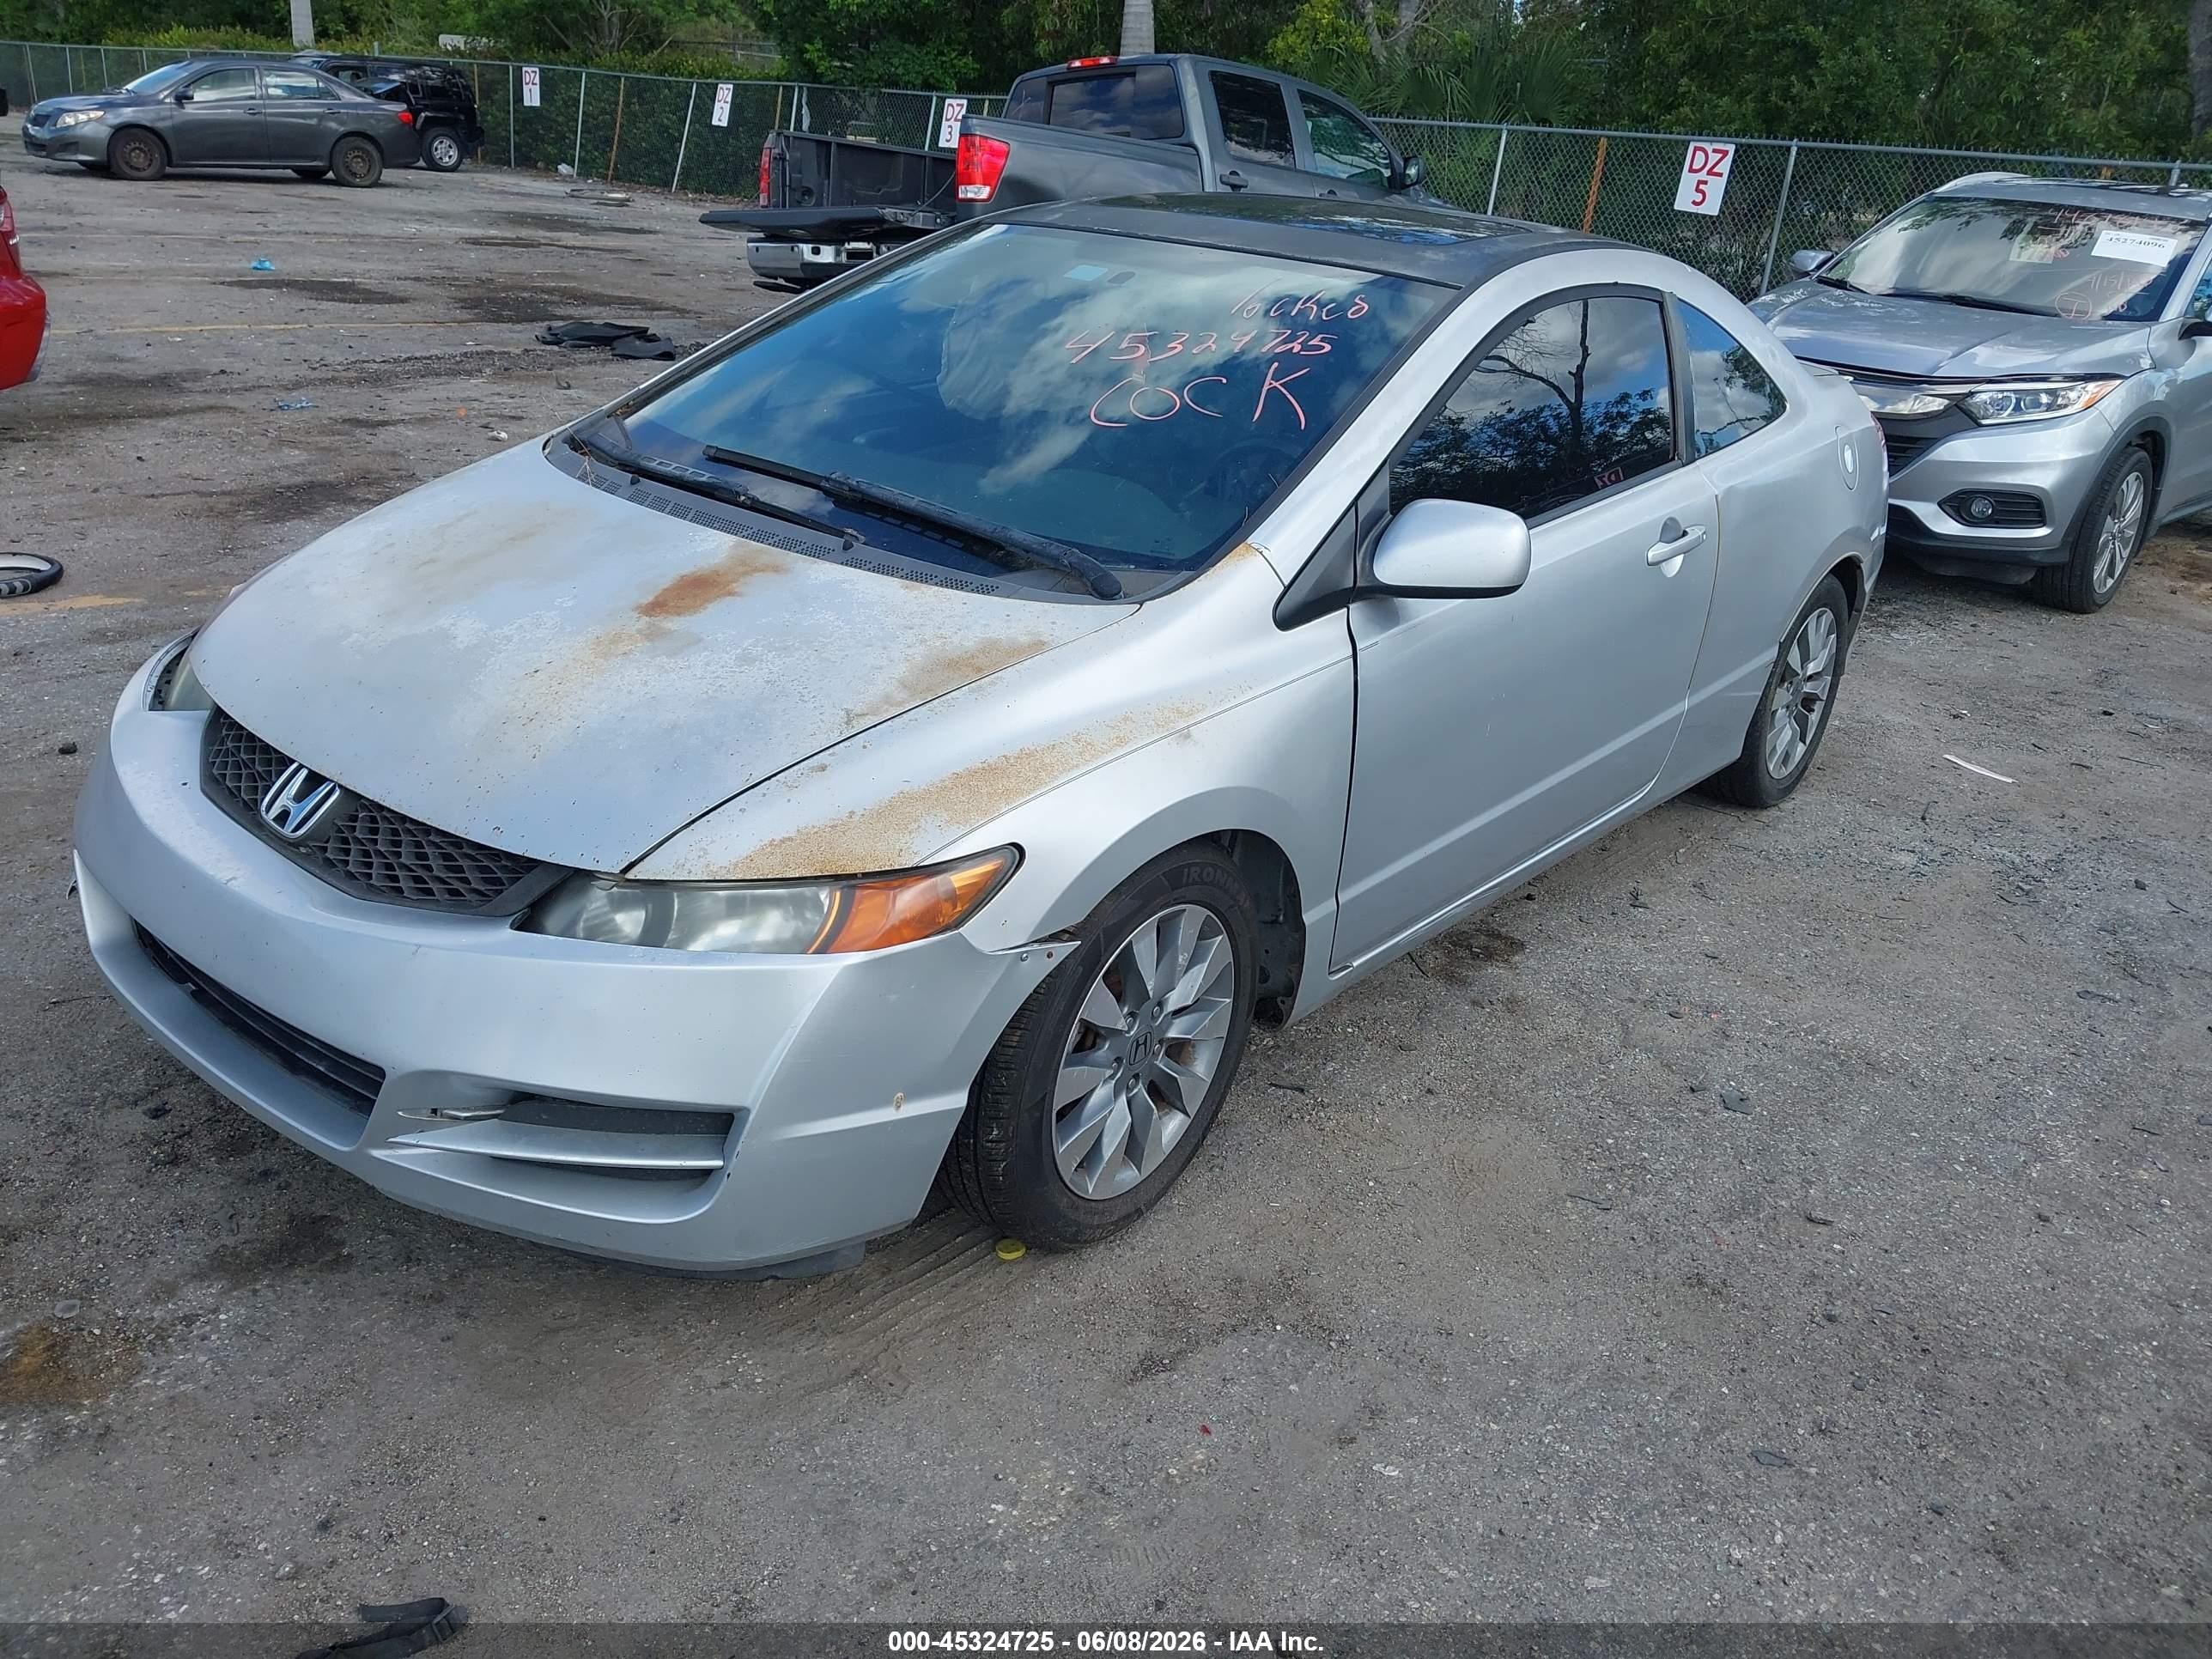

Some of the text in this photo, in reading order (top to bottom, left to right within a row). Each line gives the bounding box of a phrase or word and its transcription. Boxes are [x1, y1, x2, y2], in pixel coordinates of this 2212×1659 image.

[524, 70, 538, 86] DZ
[717, 87, 732, 104] DZ
[718, 106, 724, 122] 2
[945, 103, 964, 122] DZ
[945, 125, 953, 143] 3
[1688, 145, 1729, 178] DZ
[1691, 179, 1708, 206] 5
